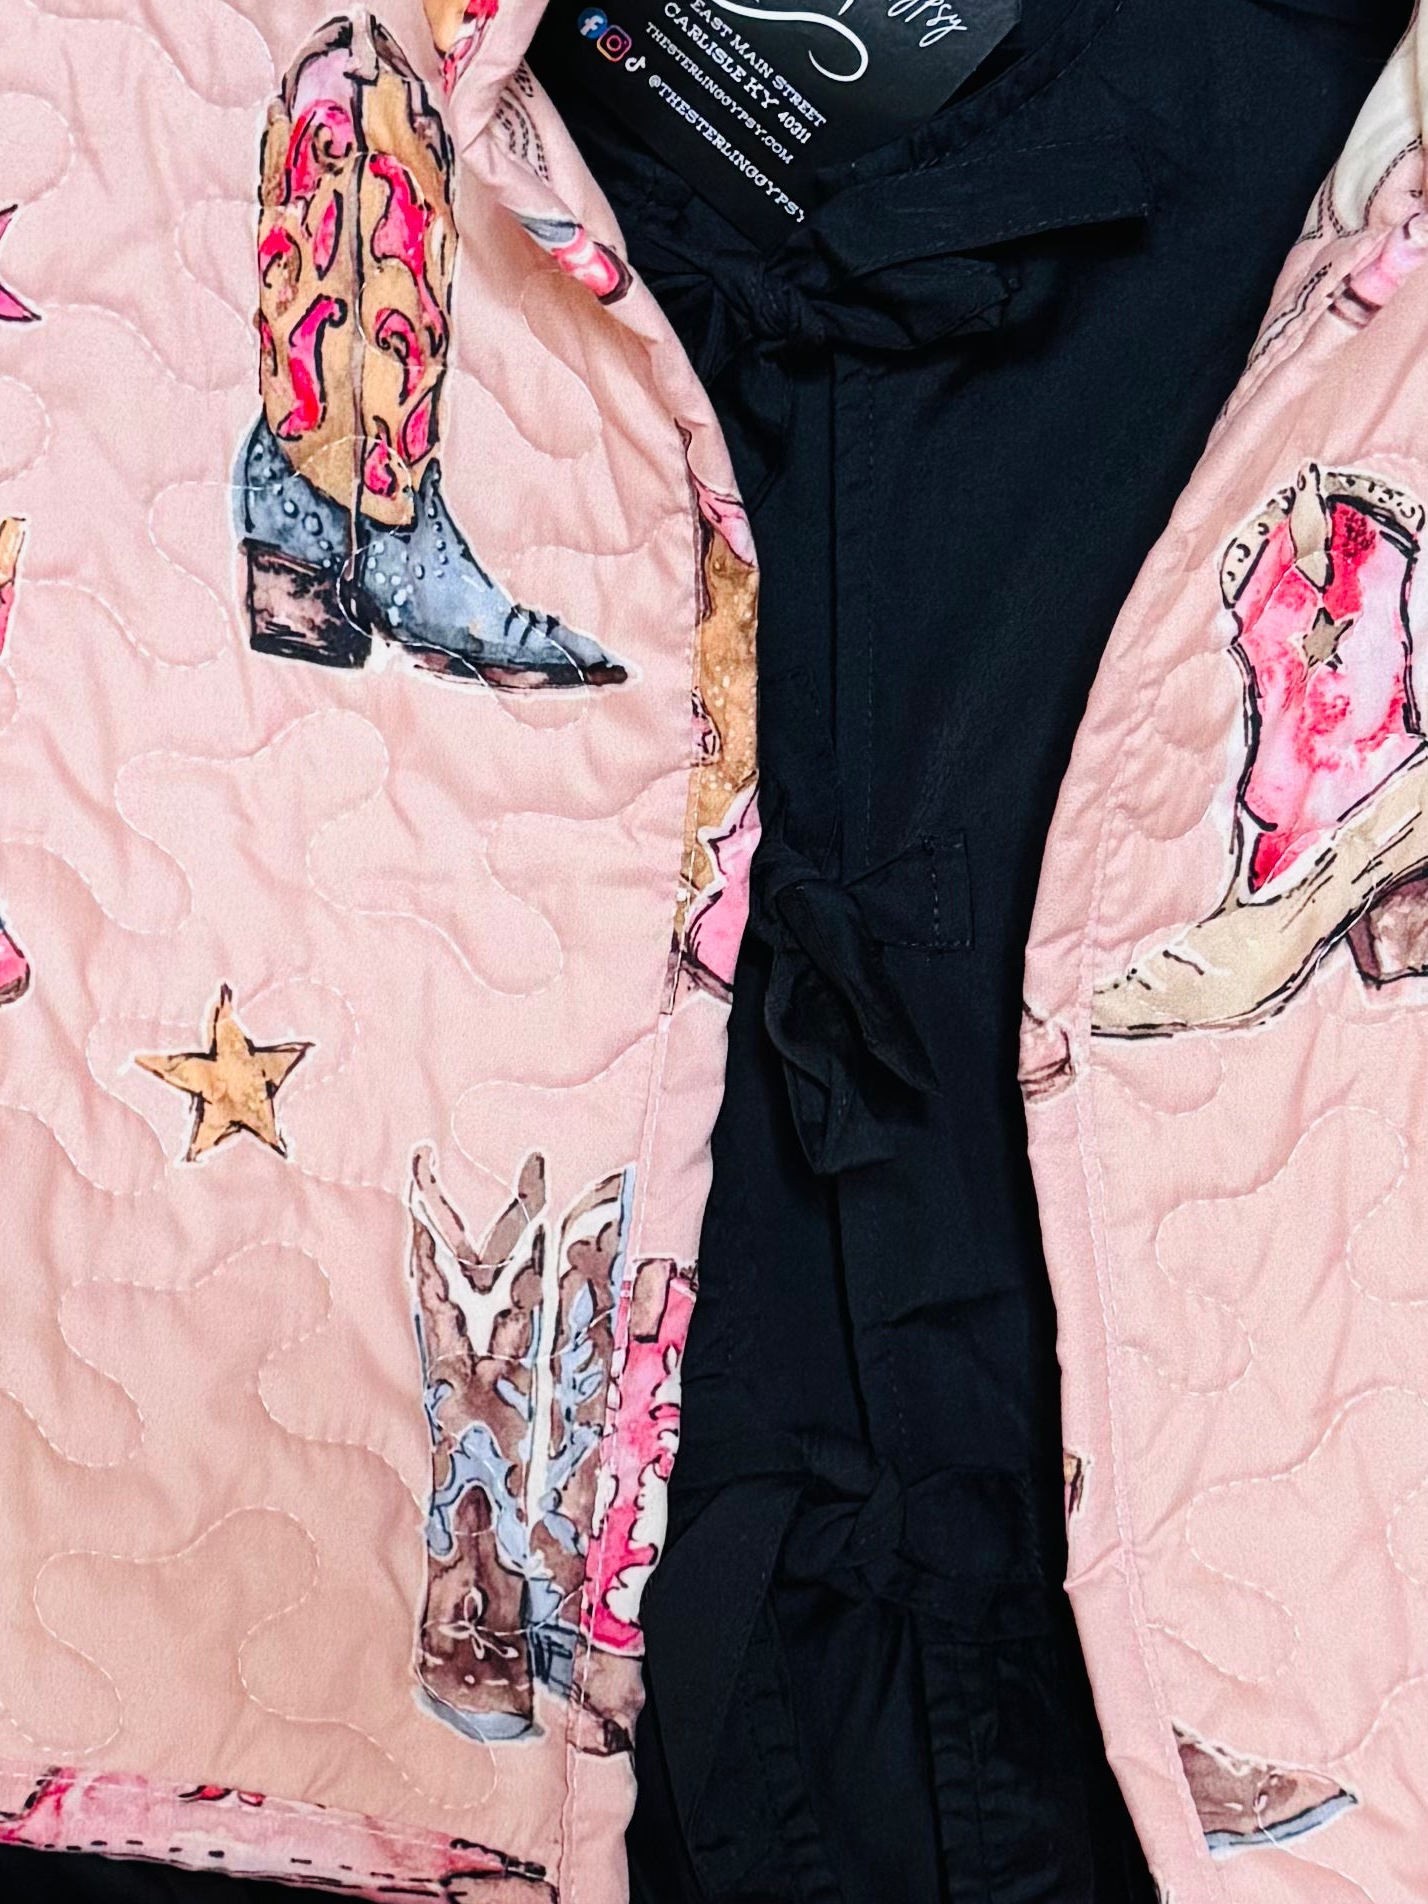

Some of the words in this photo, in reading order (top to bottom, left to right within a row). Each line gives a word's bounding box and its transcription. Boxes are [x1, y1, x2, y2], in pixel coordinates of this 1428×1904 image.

[645, 21, 795, 165] THESTERLINGGYPSY.COM
[664, 2, 747, 83] CARLISLE
[744, 76, 780, 110] KY
[777, 110, 812, 145] 40311
[729, 33, 774, 79] MAIN
[772, 75, 828, 128] STREET
